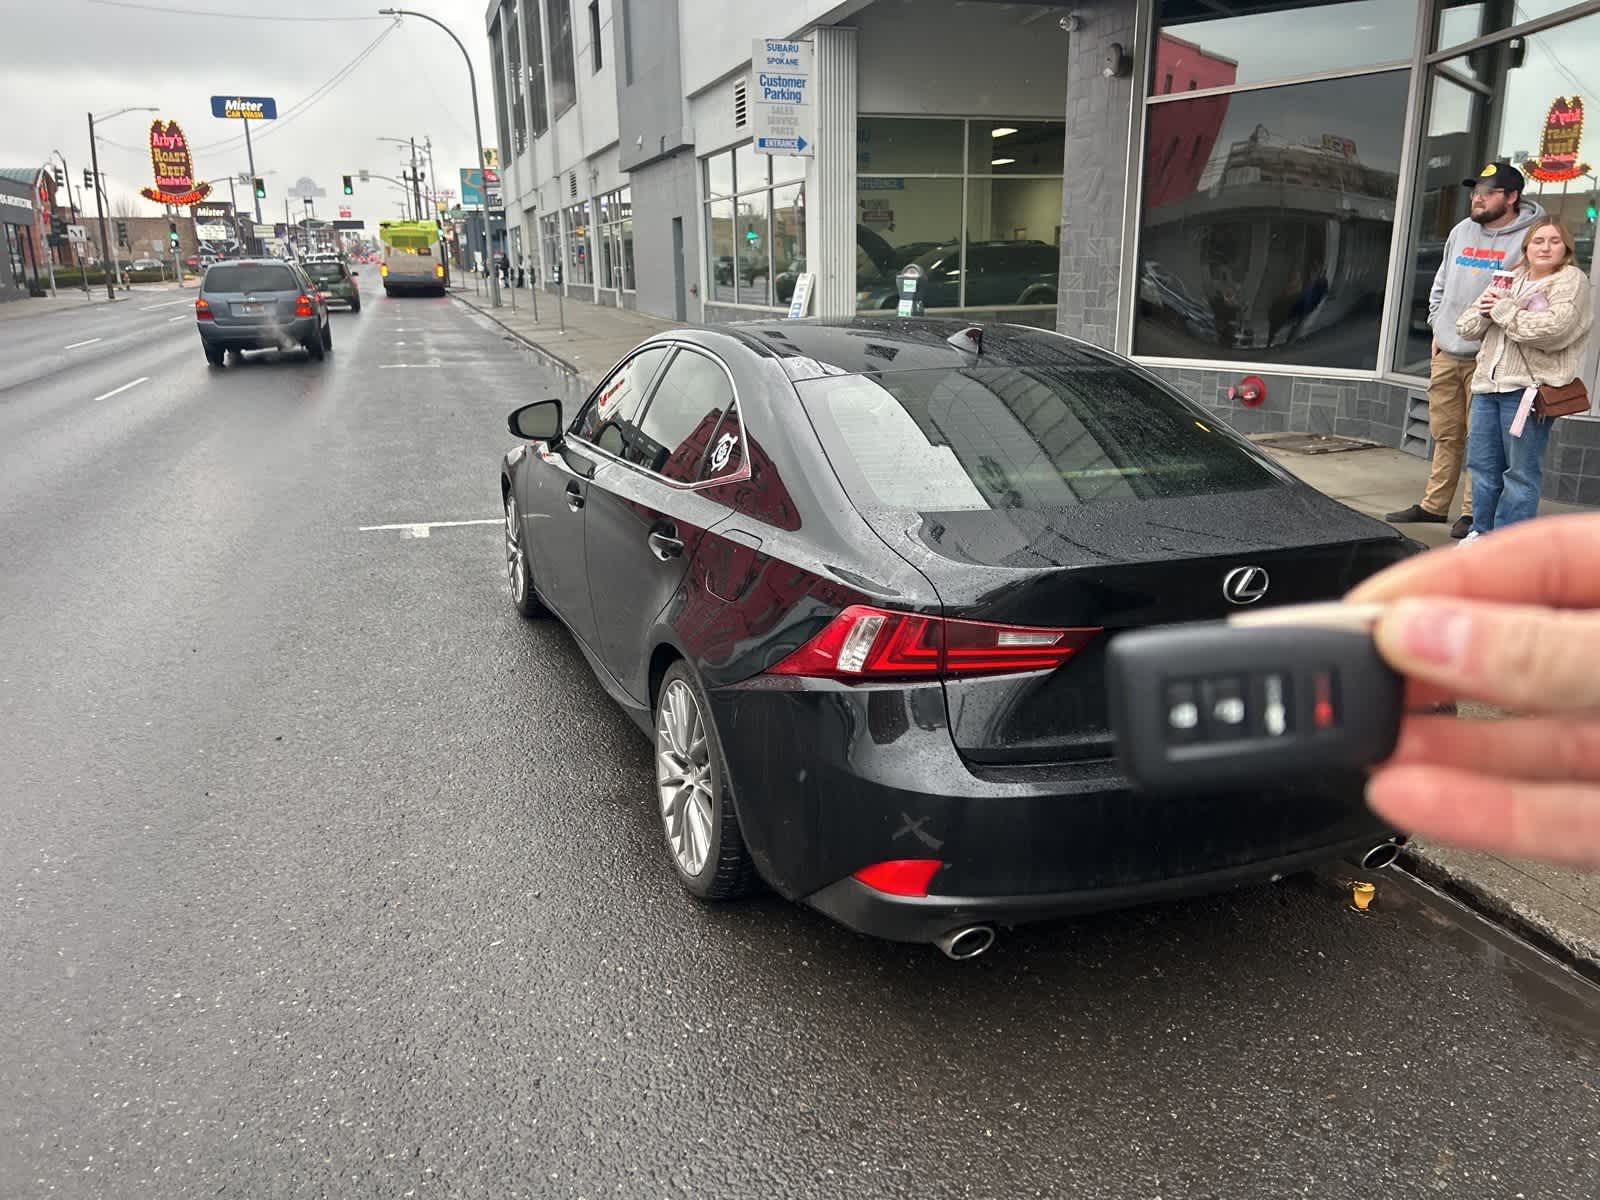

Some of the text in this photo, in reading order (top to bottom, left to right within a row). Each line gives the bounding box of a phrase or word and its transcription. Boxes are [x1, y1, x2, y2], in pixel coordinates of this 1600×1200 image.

[767, 43, 799, 52] SUBARU
[767, 57, 799, 66] SPOKANE
[760, 74, 806, 88] Customer
[765, 87, 802, 104] Parking
[225, 99, 263, 111] Mister
[242, 111, 264, 119] WASH
[153, 133, 182, 149] Arby's
[154, 148, 186, 162] ROAST
[160, 163, 185, 176] BEEF
[197, 206, 225, 217] Mister
